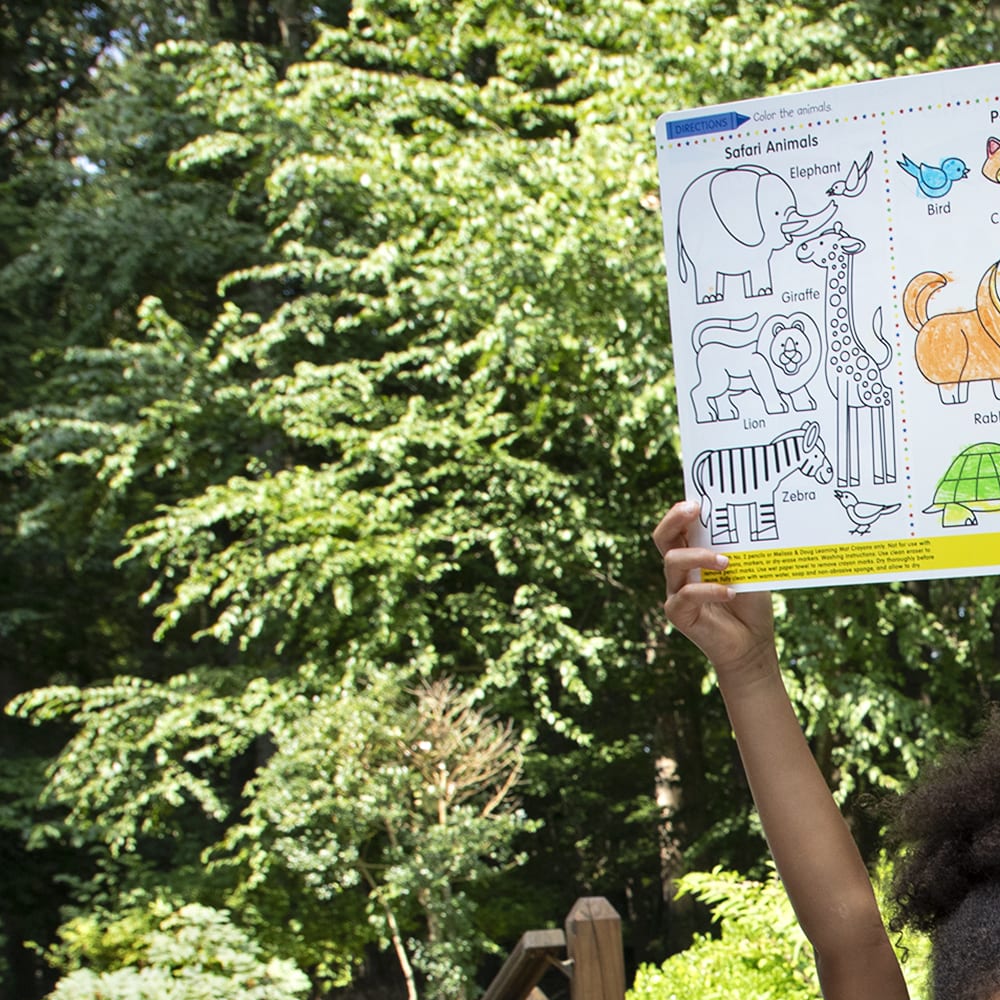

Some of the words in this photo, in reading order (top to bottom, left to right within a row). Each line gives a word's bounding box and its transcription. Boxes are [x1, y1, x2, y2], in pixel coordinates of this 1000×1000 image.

[752, 110, 777, 123] Color
[778, 108, 795, 120] the
[675, 118, 728, 135] DIRECTIONS
[724, 142, 762, 160] Safari
[766, 134, 819, 154] Animals
[789, 161, 841, 180] Elephant
[927, 202, 951, 216] Bird
[781, 289, 820, 304] Giraffe
[743, 417, 767, 430] Lion
[782, 489, 816, 503] Zebra
